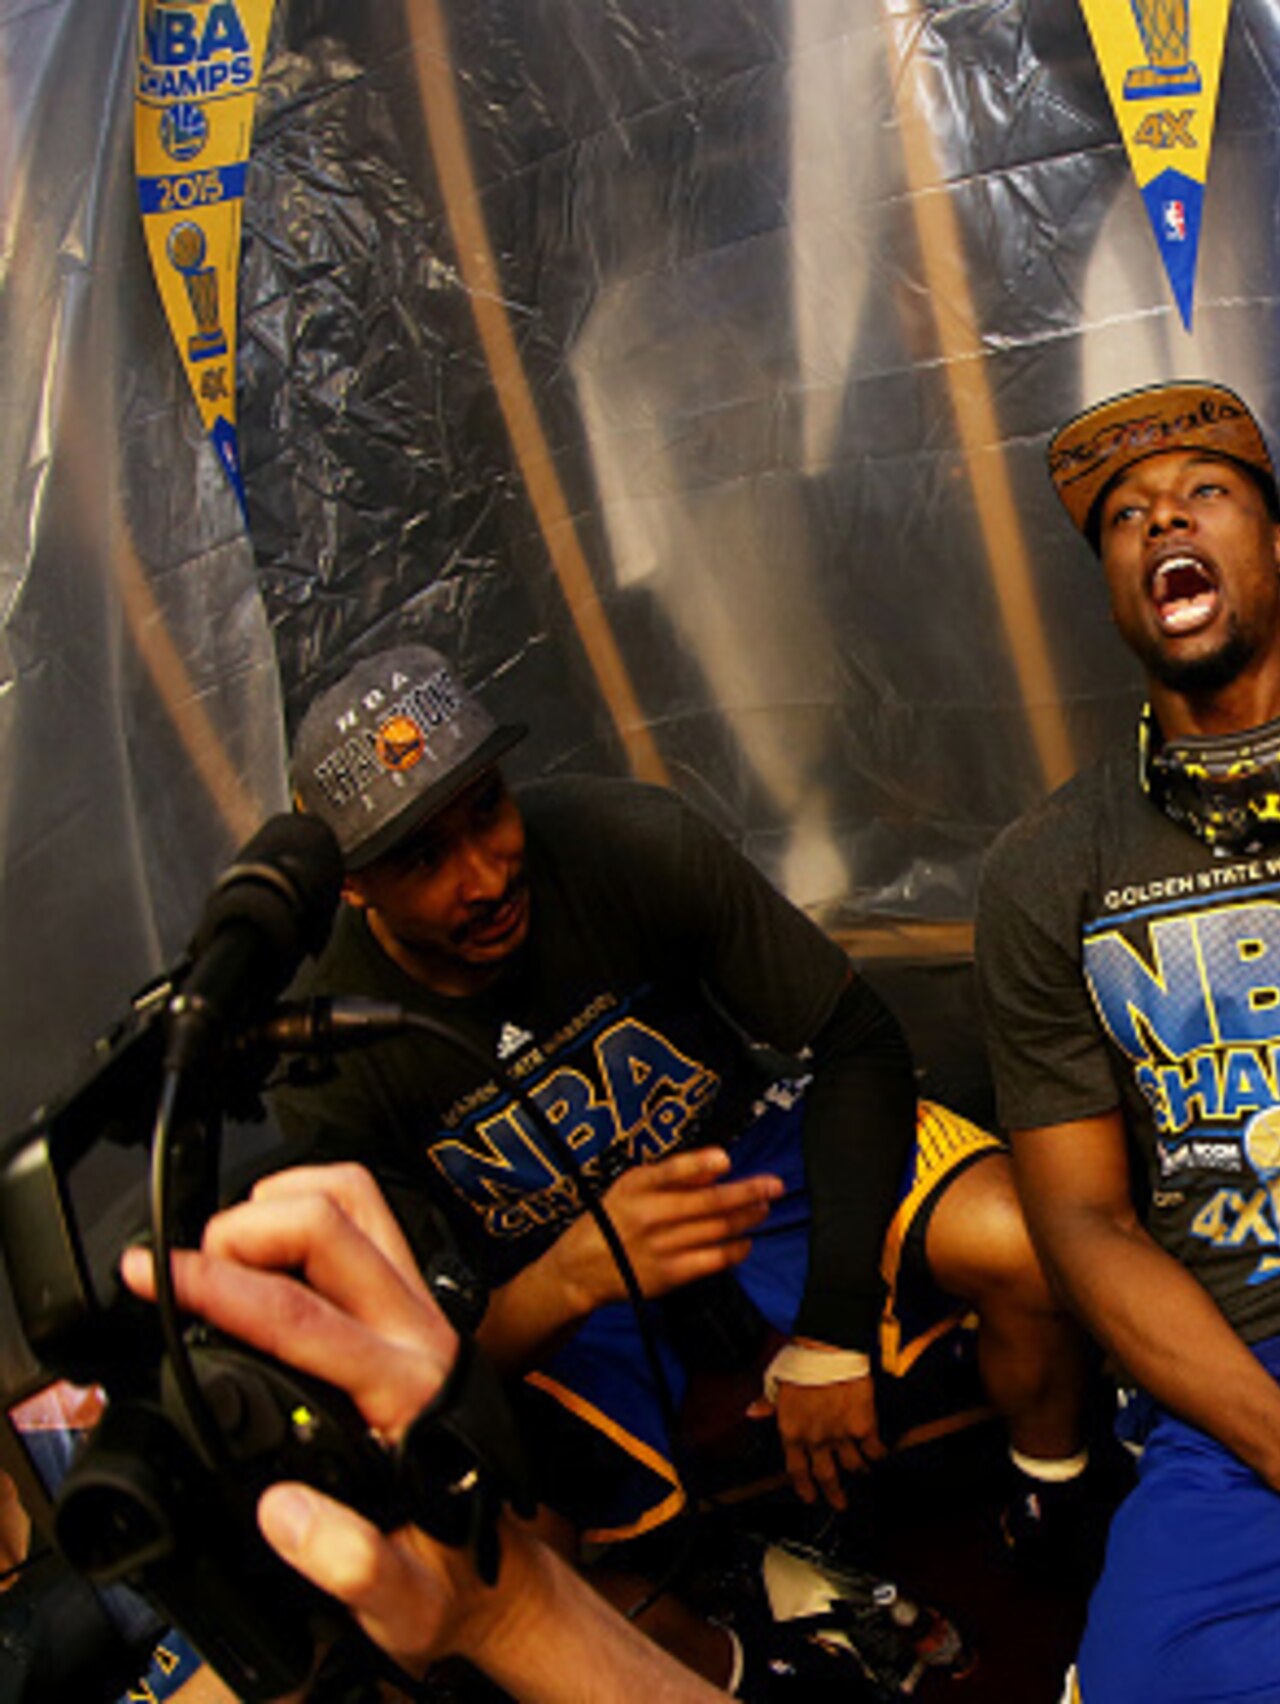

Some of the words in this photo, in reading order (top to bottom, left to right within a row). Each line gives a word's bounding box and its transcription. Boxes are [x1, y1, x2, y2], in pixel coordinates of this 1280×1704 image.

[1133, 108, 1199, 149] 4X
[157, 168, 224, 210] 2015
[1104, 874, 1195, 910] GOLDEN
[427, 1016, 704, 1216] NBA
